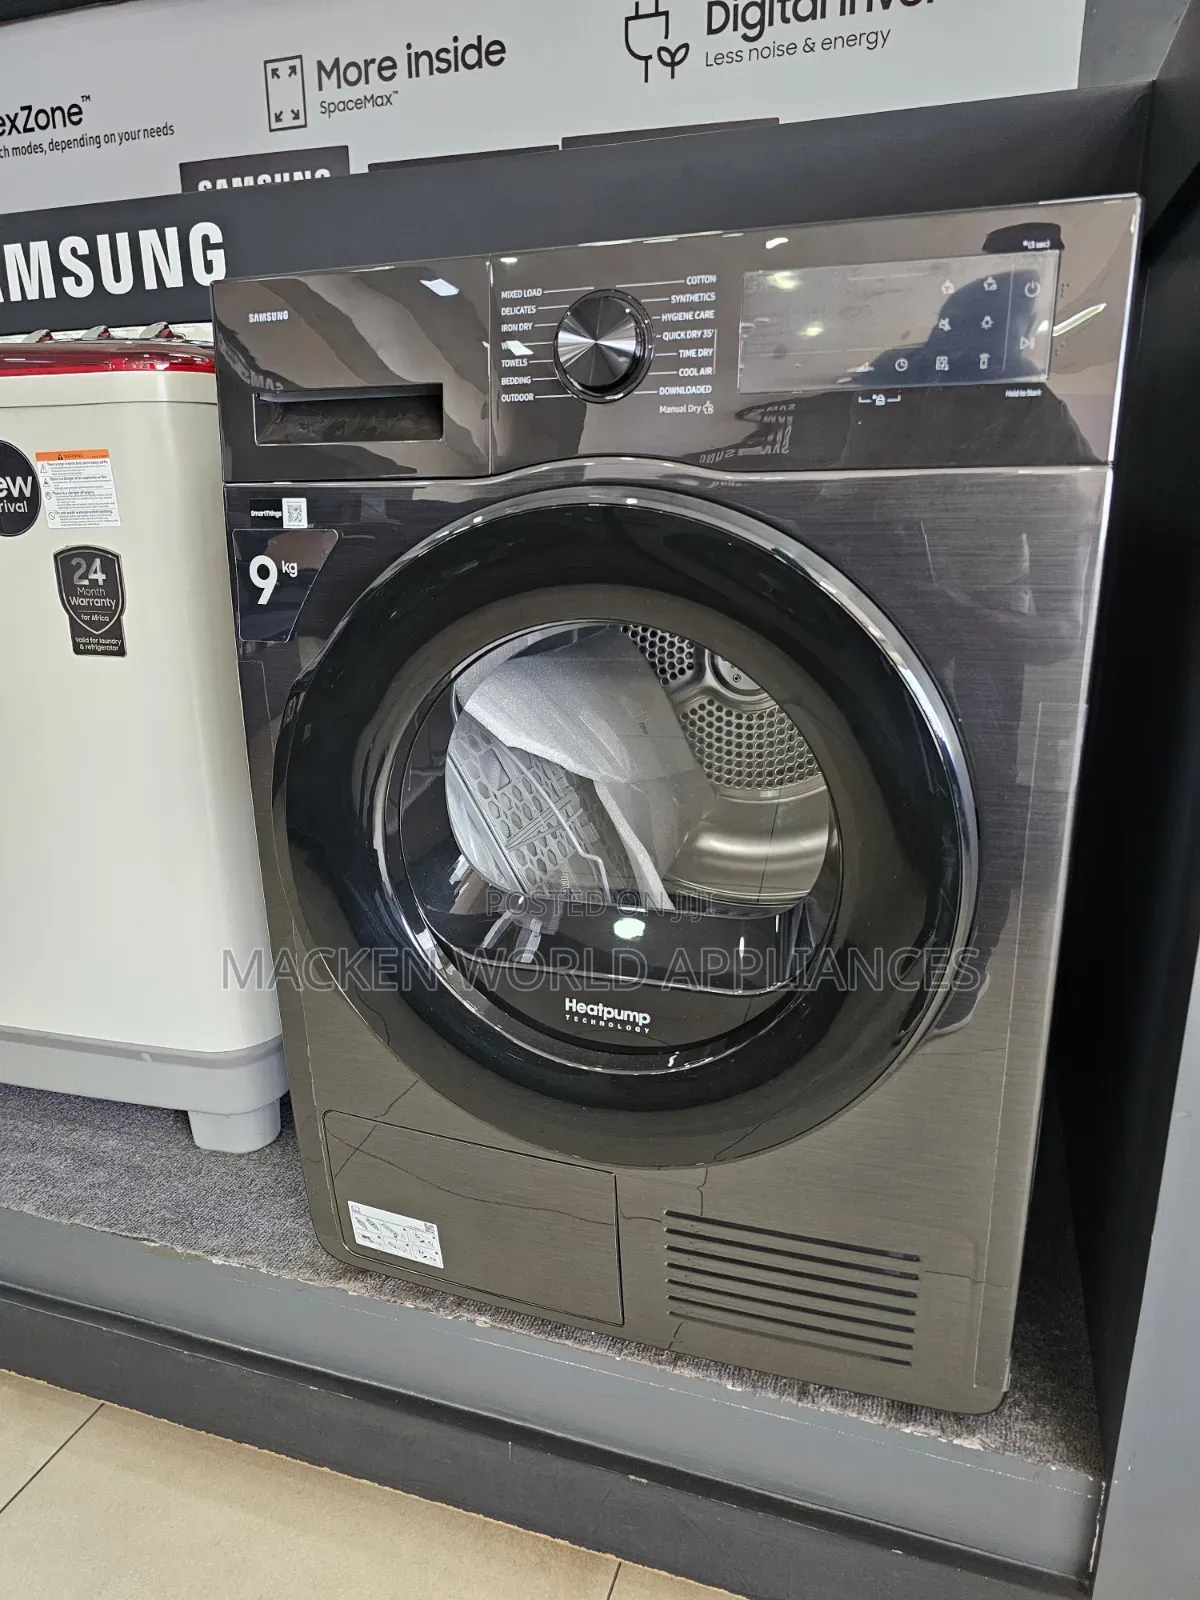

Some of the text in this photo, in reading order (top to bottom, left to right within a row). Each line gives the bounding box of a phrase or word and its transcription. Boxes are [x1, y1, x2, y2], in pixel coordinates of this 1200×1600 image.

[705, 29, 892, 67] Less noise & energy
[316, 35, 507, 92] More inside
[11, 141, 47, 156] modes,
[48, 133, 102, 154] depending
[103, 132, 117, 144] on
[117, 129, 142, 146] your
[142, 121, 175, 140] needs
[0, 221, 227, 303] MSUNG
[686, 274, 717, 286] COTTON
[501, 288, 543, 300] MIXED LOAD
[670, 292, 717, 304] SYNTHETICS
[248, 310, 289, 323] SAMSUNG
[501, 305, 537, 316] DELICATES
[661, 309, 716, 322] HYGIENE CARE
[501, 322, 534, 333] IRON DRY
[662, 330, 686, 342] QUICK
[686, 330, 702, 340] DRY
[678, 348, 714, 358] TIME DRY
[501, 358, 528, 368] TOWELS
[678, 366, 713, 377] COOL AIR
[501, 375, 532, 386] BEDDING
[659, 385, 713, 396] DOWNLOADED
[501, 392, 535, 403] OUTDOOR
[659, 404, 702, 415] Manual Dry
[70, 557, 107, 586] 24
[249, 555, 298, 605] 9 kg
[76, 586, 106, 596] Month
[68, 596, 117, 610] Warranty
[81, 613, 110, 622] for Africa
[90, 636, 99, 644] for
[99, 637, 122, 647] laundry
[85, 644, 120, 652] refrigerator
[565, 997, 651, 1026] Heatpump
[565, 1014, 651, 1035] TECHNOLOGY
